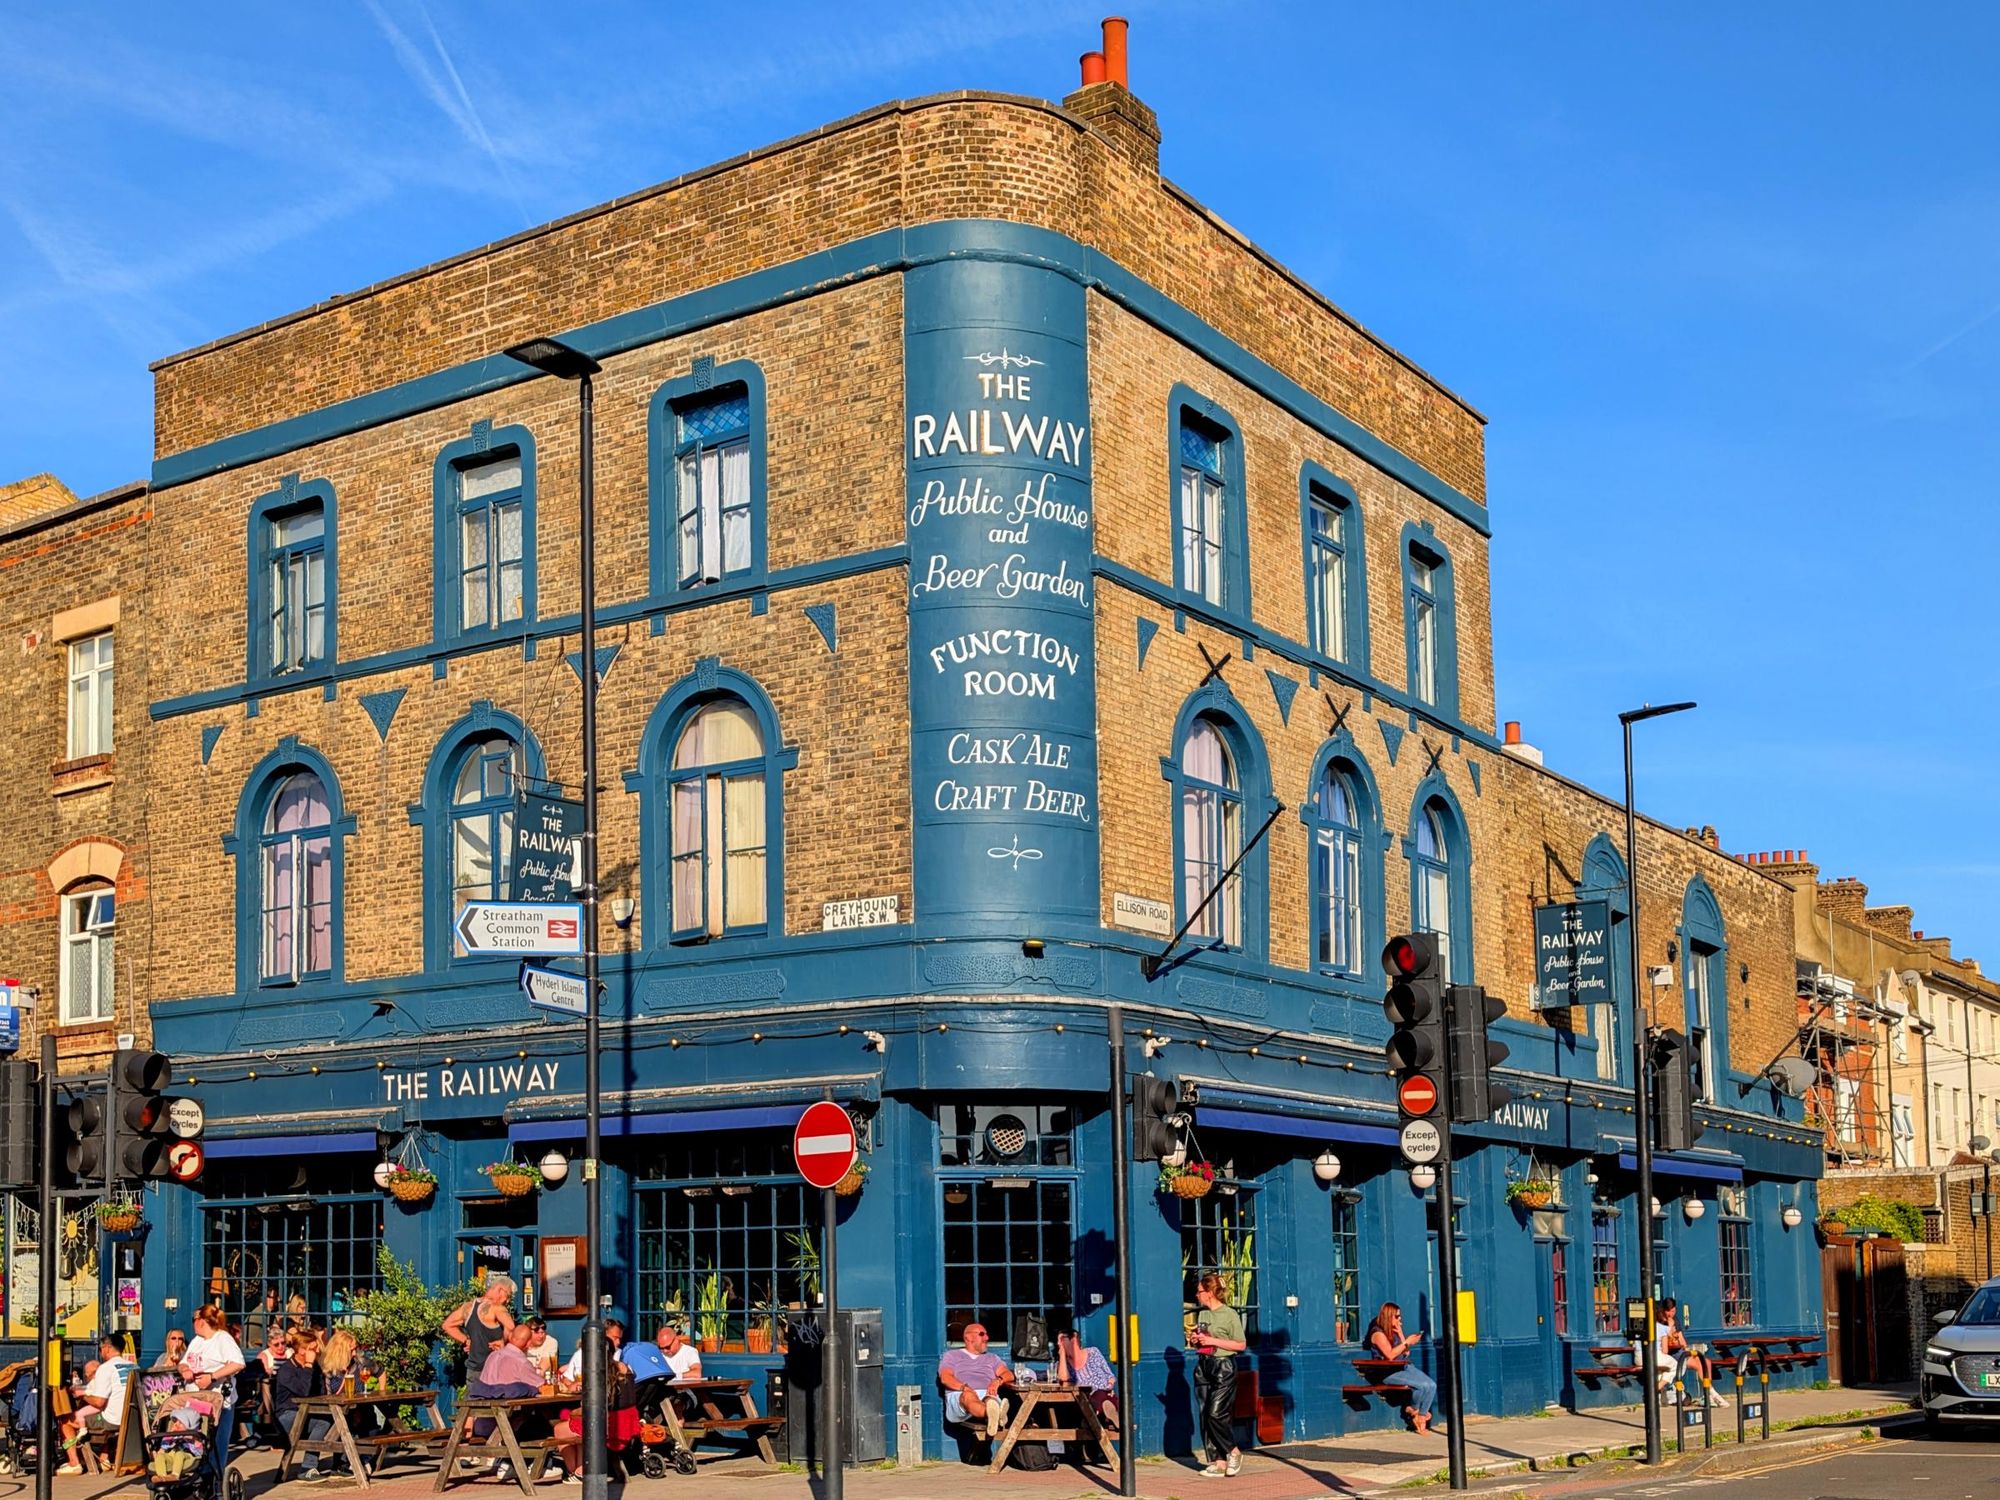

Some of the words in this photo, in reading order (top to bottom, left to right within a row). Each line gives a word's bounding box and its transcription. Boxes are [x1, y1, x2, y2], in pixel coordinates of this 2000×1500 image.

[979, 373, 1031, 401] THE
[913, 409, 1085, 467] RAILWAY
[911, 477, 1004, 527] Public
[1006, 473, 1089, 529] House
[988, 523, 1030, 545] and
[913, 554, 999, 598] Beer
[996, 553, 1089, 607] Garden
[930, 630, 1080, 676] FUNCTION
[964, 670, 1056, 700] ROOM
[948, 733, 1026, 764] CASK
[1021, 734, 1071, 769] ALE
[934, 780, 1017, 811] CRAFT
[1023, 780, 1090, 822] BEER
[542, 817, 563, 833] THE
[520, 829, 573, 856] RAILWA
[520, 859, 550, 878] Public
[549, 862, 572, 883] Hou
[542, 882, 555, 892] and
[483, 910, 544, 921] Streatham
[824, 898, 896, 916] GREYHOUND
[1117, 900, 1147, 916] ELLISON
[1149, 907, 1168, 920] ROAD
[486, 923, 540, 934] Common
[1562, 920, 1583, 931] THE
[491, 936, 535, 948] Station
[1542, 930, 1604, 950] RAILWAY
[1544, 955, 1574, 973] Public
[1575, 951, 1605, 969] House
[1568, 968, 1582, 978] and
[535, 974, 560, 991] Hyderi
[561, 981, 585, 996] Islamic
[1546, 979, 1572, 993] Beer
[1573, 975, 1606, 992] Garden
[551, 991, 575, 1007] Centre
[383, 1072, 428, 1101] THE
[441, 1062, 559, 1097] RAILWAY
[171, 1107, 200, 1118] Except
[171, 1120, 199, 1129] cycles
[1405, 1130, 1437, 1141] Except
[1407, 1143, 1437, 1154] cycles
